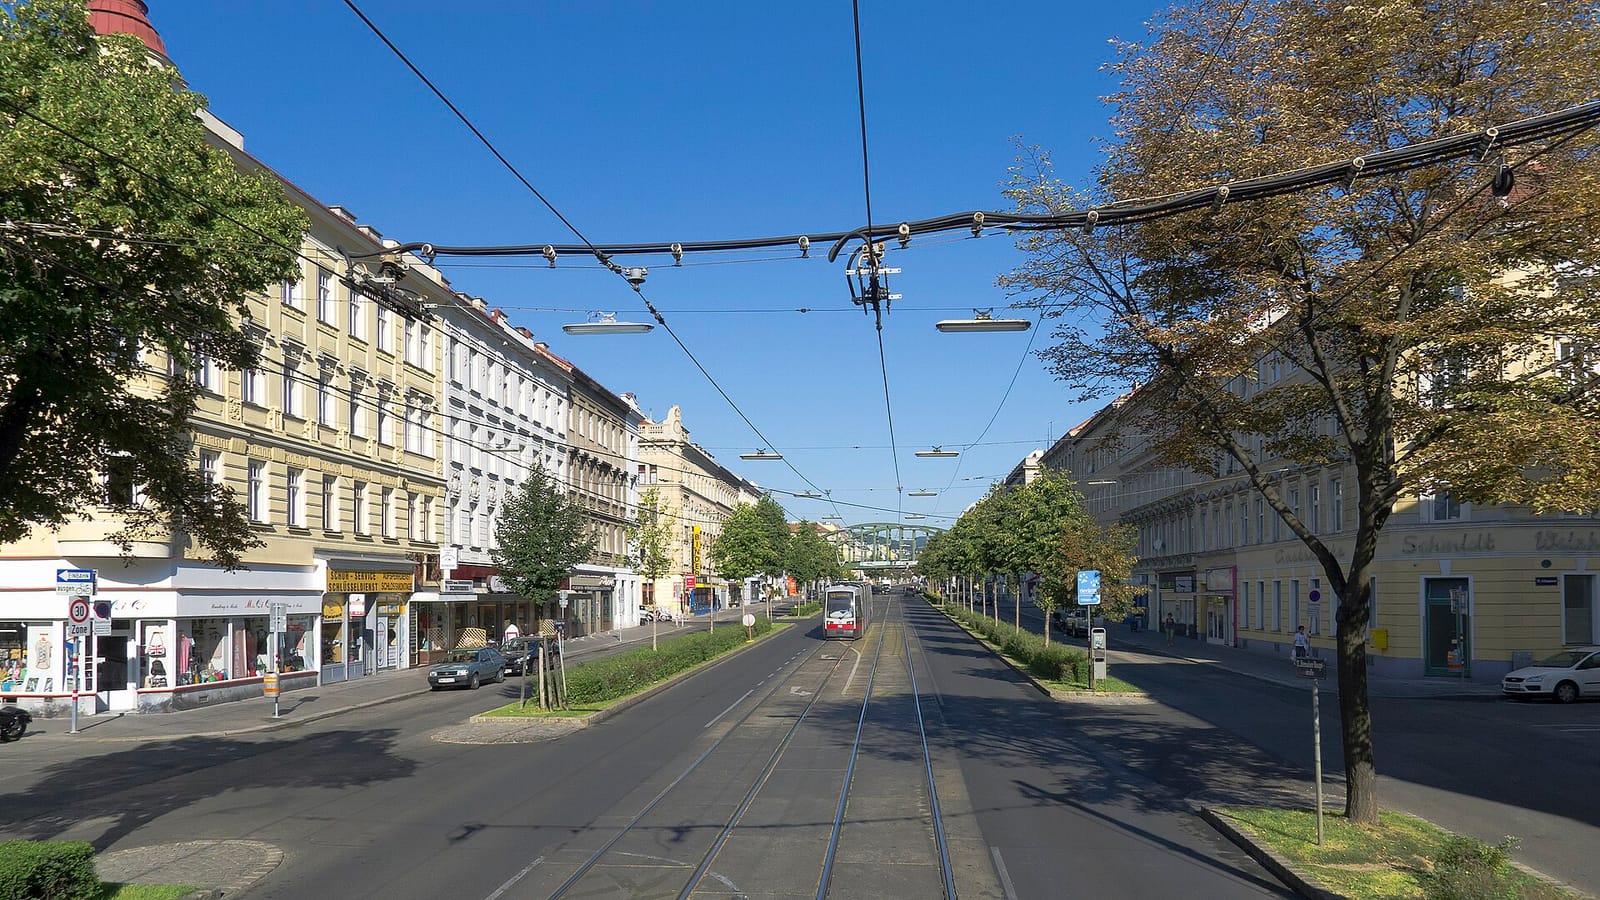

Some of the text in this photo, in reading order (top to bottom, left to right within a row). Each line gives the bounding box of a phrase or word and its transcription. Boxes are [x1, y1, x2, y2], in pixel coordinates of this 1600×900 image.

[354, 571, 376, 581] SERVICE
[328, 580, 378, 592] SCHLÜSSELDIENST
[74, 605, 85, 617] 30
[71, 624, 88, 635] Zone
